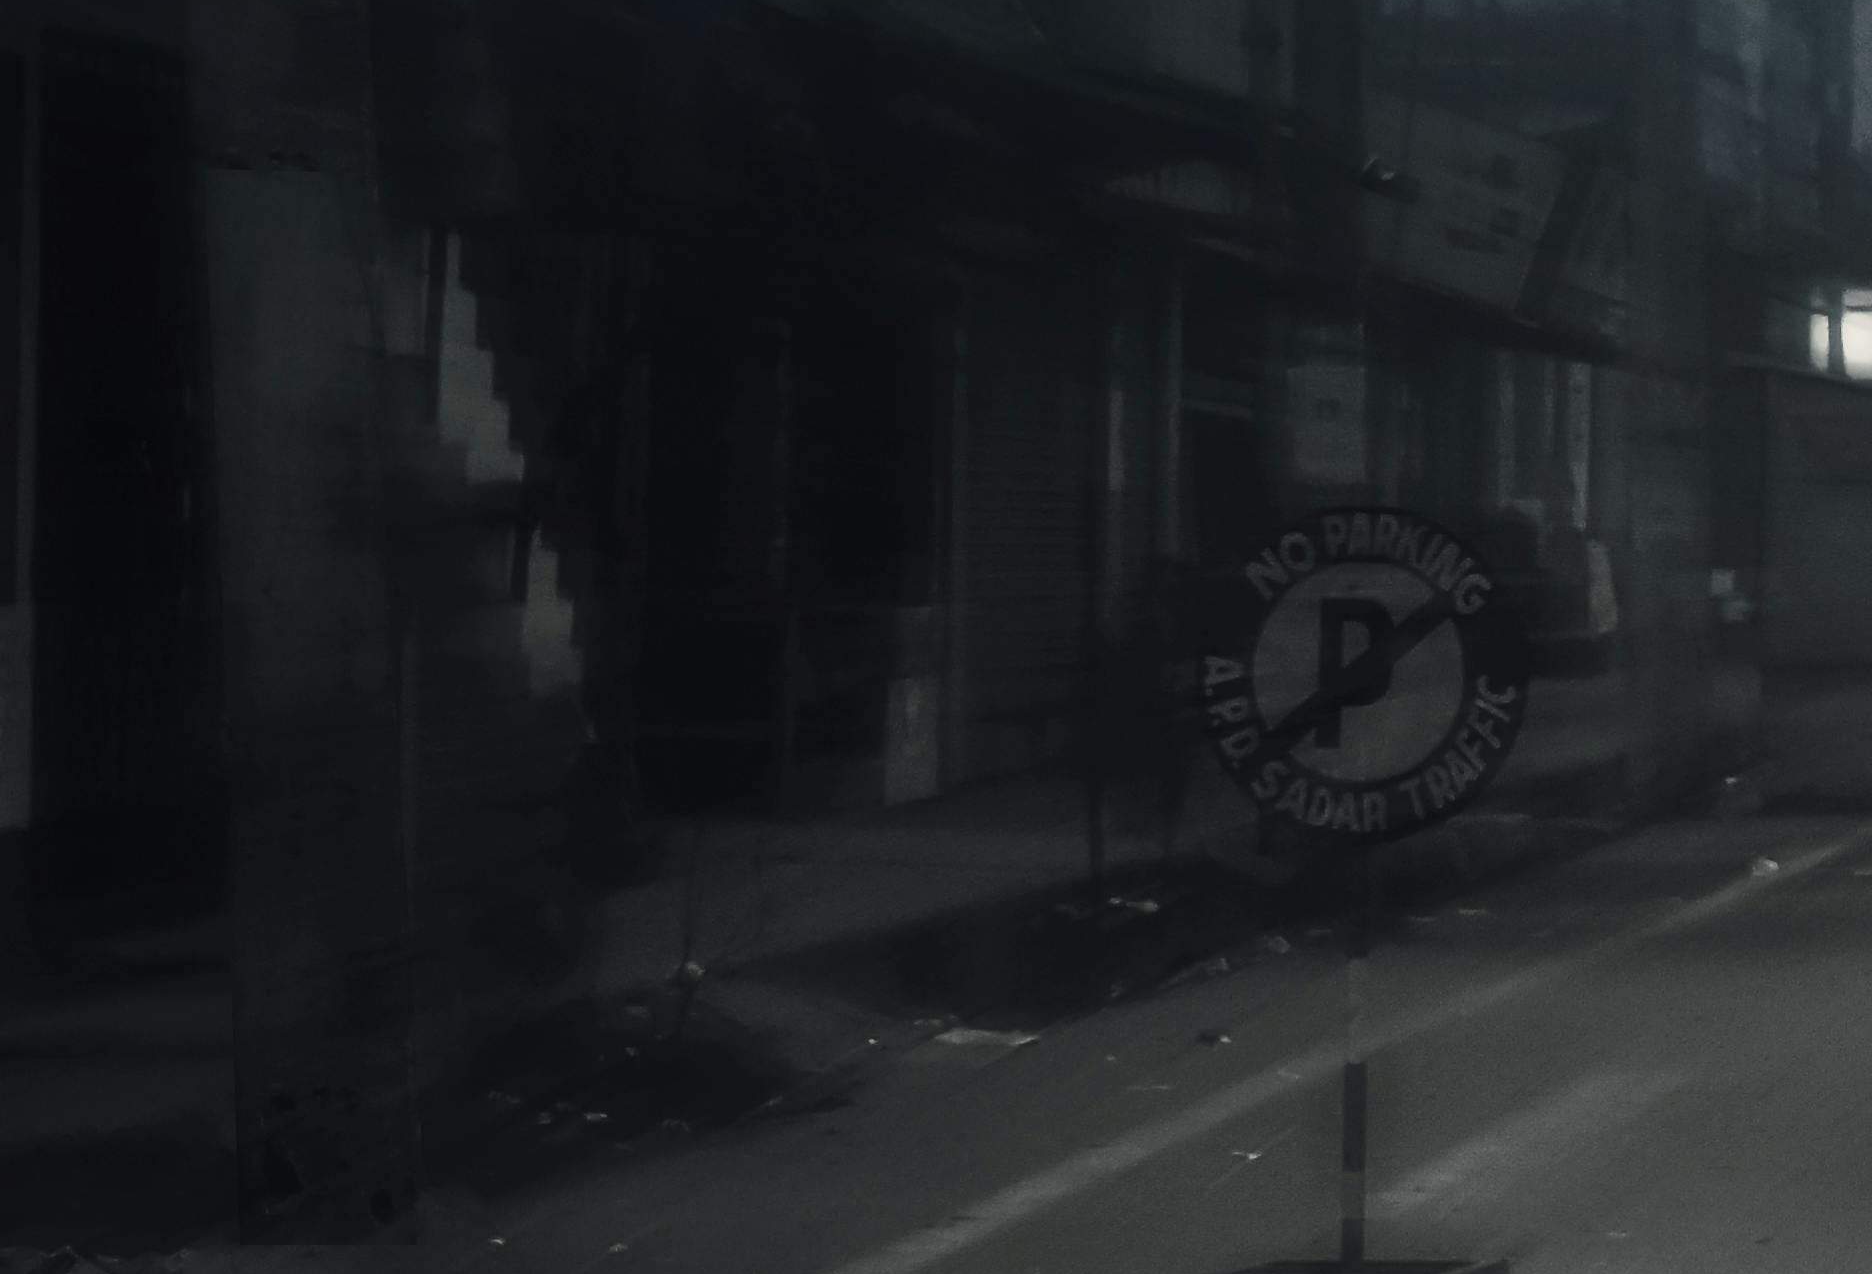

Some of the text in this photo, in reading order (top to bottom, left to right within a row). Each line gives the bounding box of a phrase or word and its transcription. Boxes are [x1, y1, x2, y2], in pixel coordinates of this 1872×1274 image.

[1244, 511, 1493, 615] NO PARKING
[1250, 759, 1388, 832] SADAR
[1398, 674, 1517, 820] TRAFFIC
